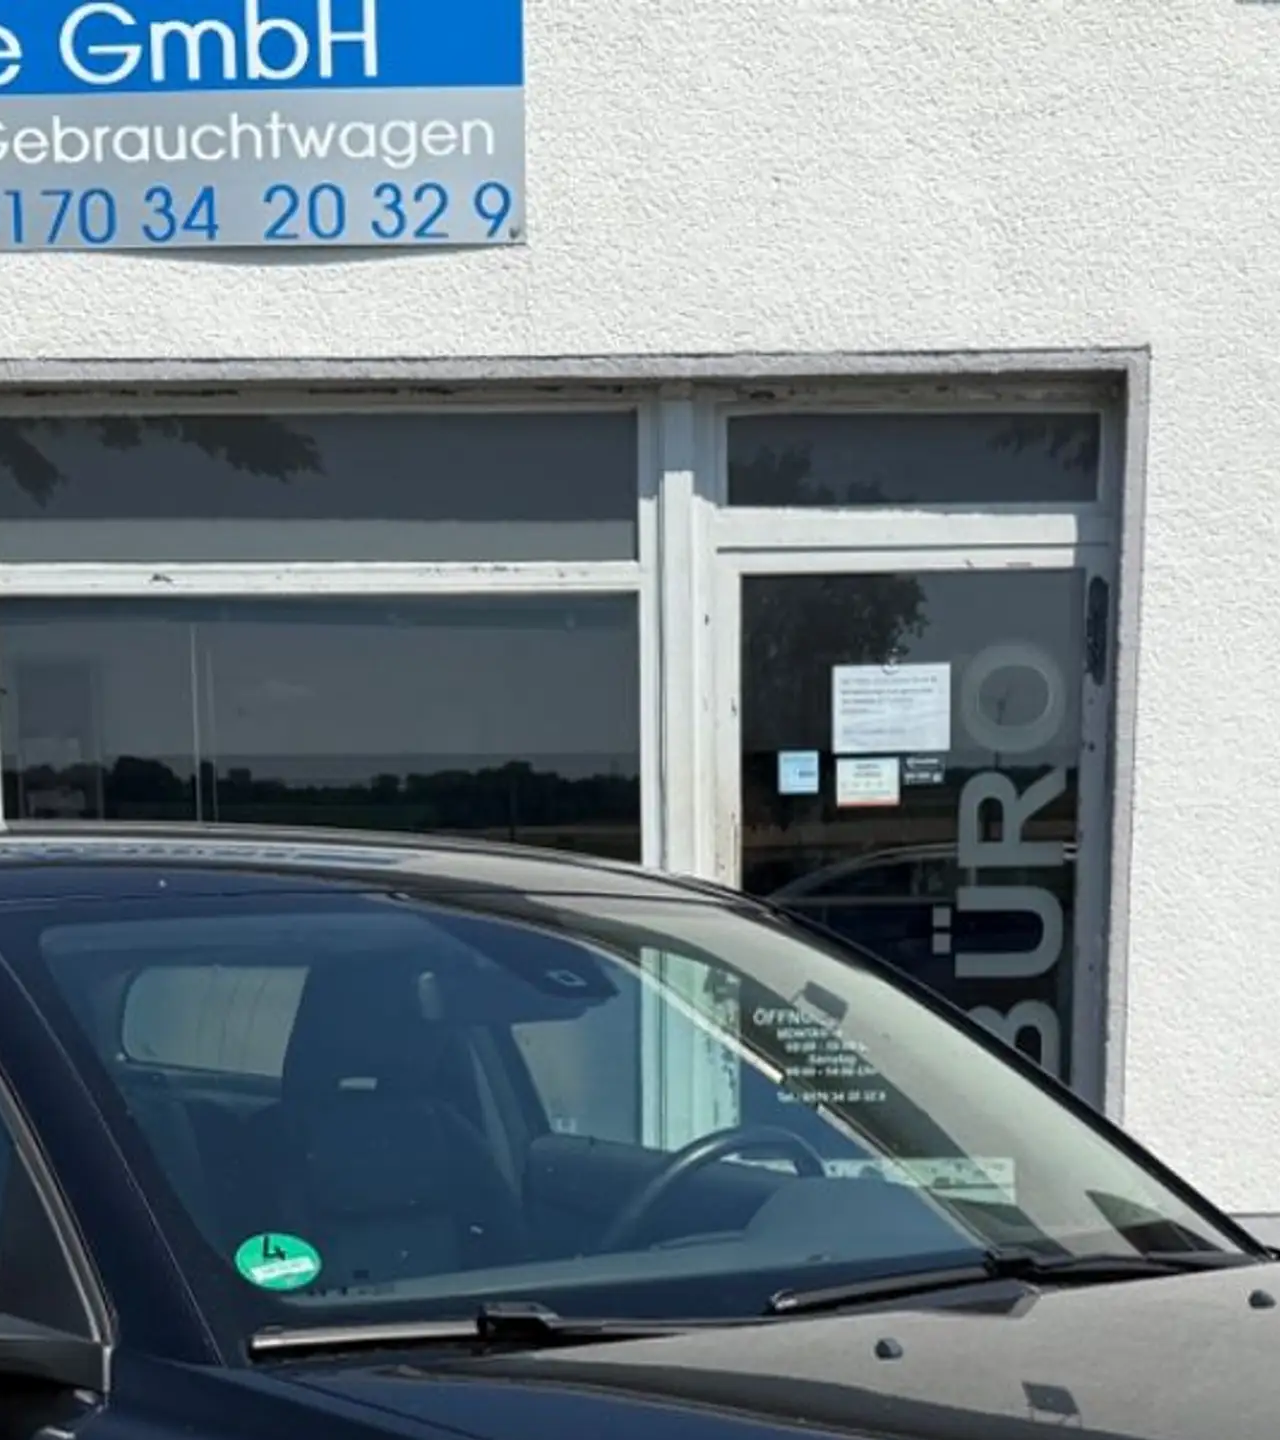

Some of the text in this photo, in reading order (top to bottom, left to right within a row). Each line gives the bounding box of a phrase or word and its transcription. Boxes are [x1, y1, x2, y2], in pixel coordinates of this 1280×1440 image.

[59, 0, 378, 85] GmbH
[141, 186, 220, 243] 34
[263, 183, 346, 241] 20
[370, 182, 449, 239] 32
[473, 181, 512, 236] 9
[933, 644, 1067, 1084] BÜRO
